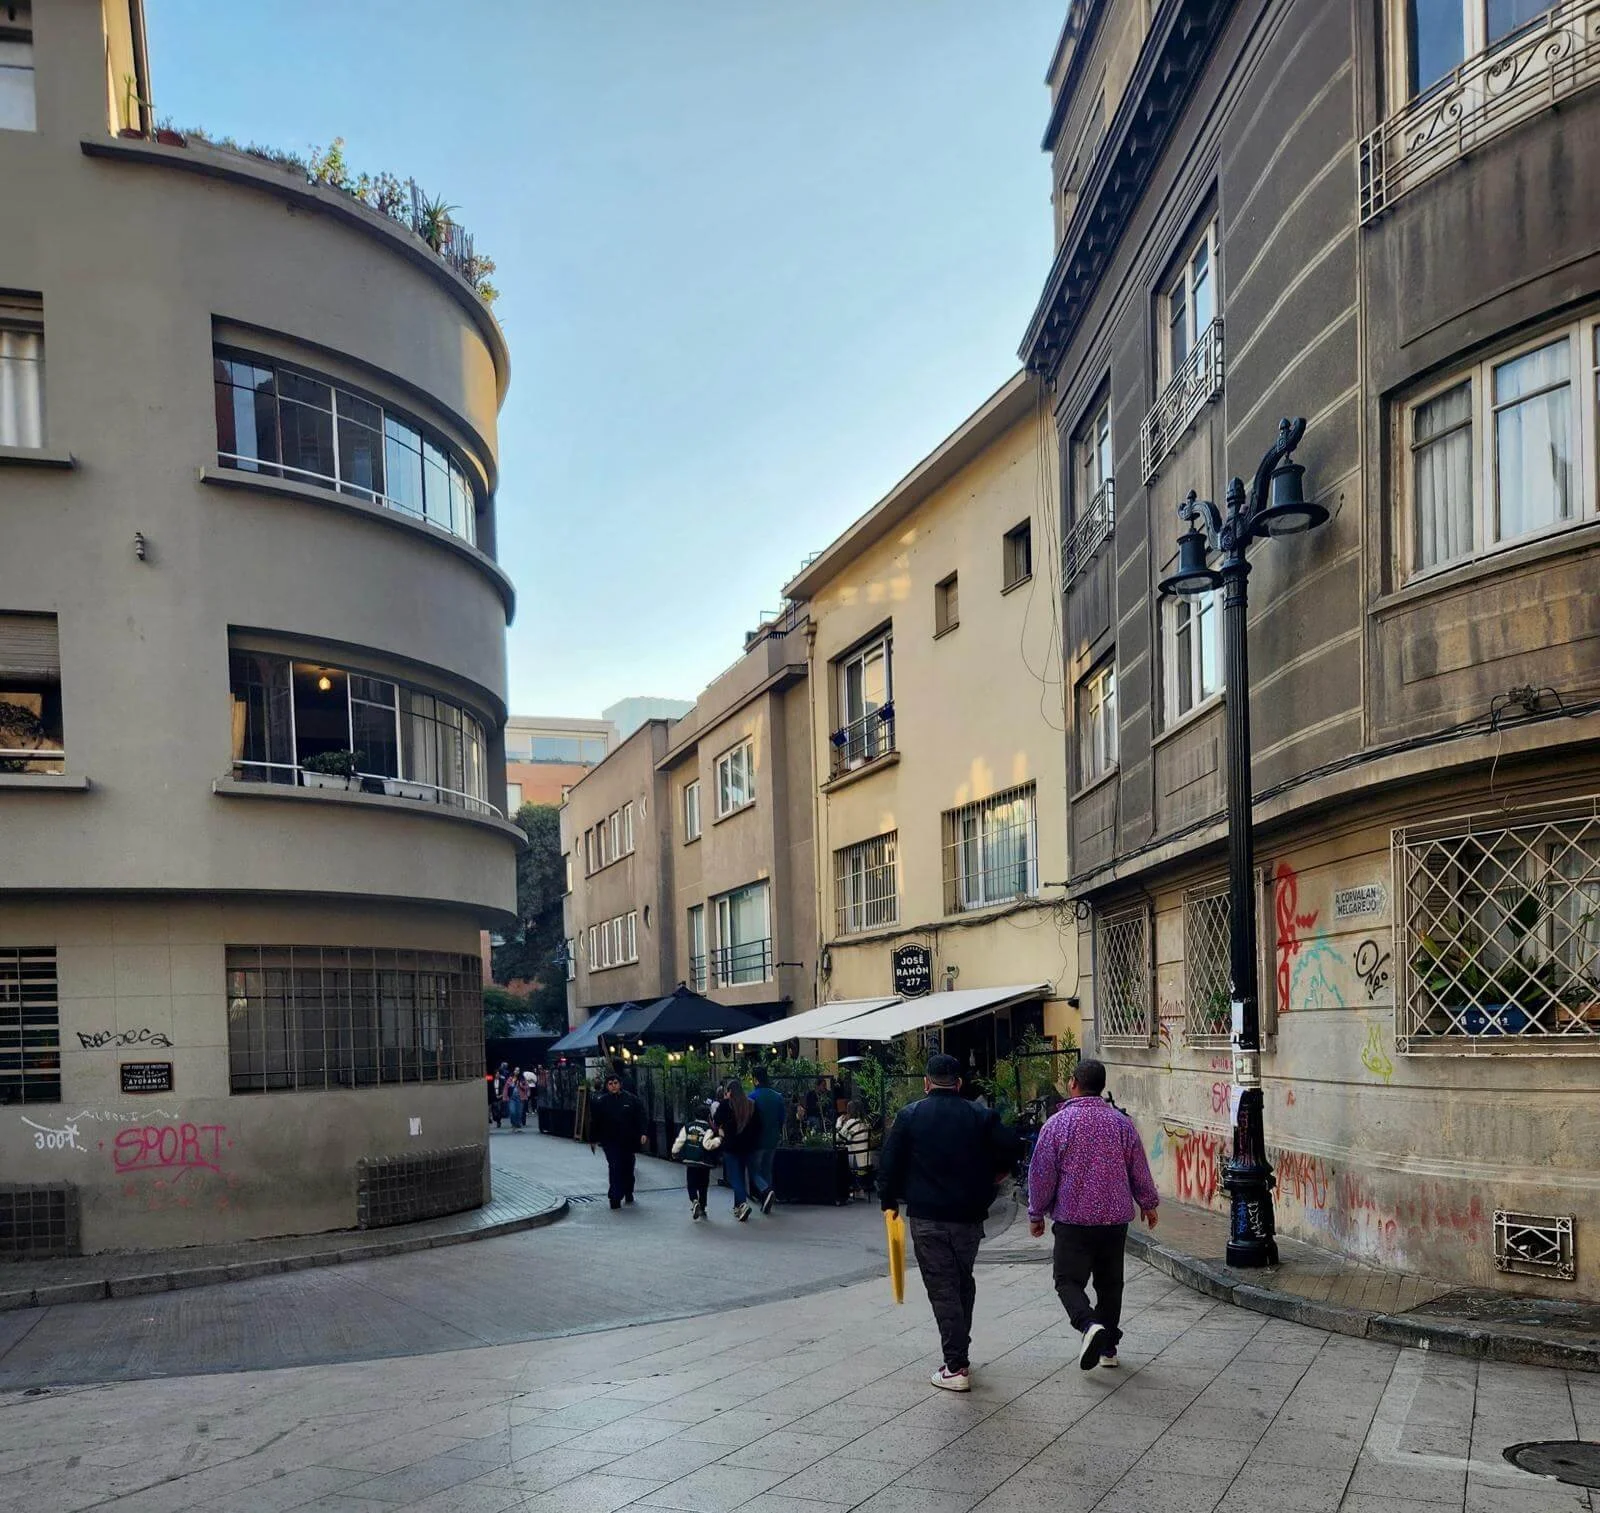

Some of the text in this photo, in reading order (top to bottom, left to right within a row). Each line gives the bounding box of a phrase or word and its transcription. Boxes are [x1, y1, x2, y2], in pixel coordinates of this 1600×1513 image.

[1341, 887, 1376, 903] CORVALAN
[1337, 899, 1377, 915] MELGAREJO
[901, 954, 924, 965] JOSÉ
[896, 965, 928, 976] RAMÓN
[906, 978, 920, 986] 277
[113, 1123, 227, 1168] SPORT
